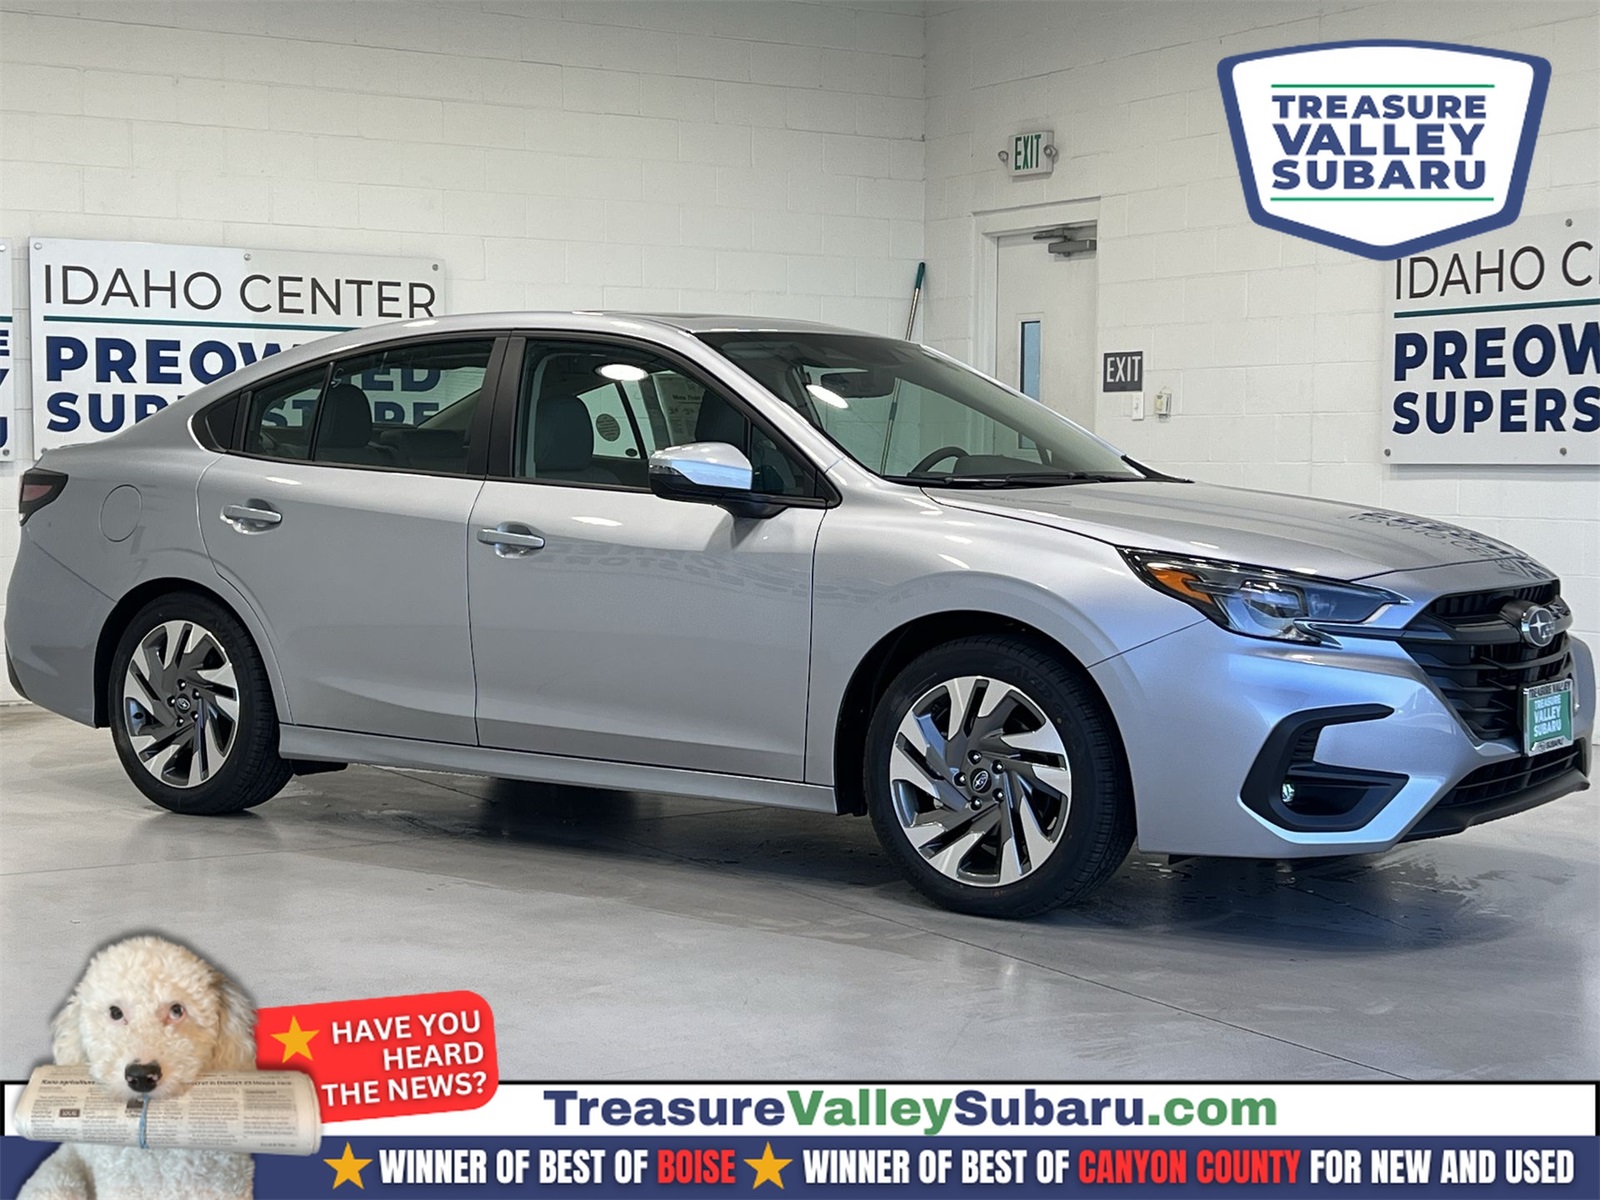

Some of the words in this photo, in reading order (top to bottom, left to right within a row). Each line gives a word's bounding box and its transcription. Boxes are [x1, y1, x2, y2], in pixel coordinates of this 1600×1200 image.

[1014, 133, 1042, 171] EXIT
[44, 263, 222, 311] IDAHO
[239, 273, 436, 318] CENTER
[1396, 245, 1545, 300] IDAHO
[1106, 355, 1142, 383] EXIT
[1392, 385, 1600, 434] SUPERS
[1533, 705, 1561, 723] VALLEY
[1533, 719, 1562, 737] SUBARU
